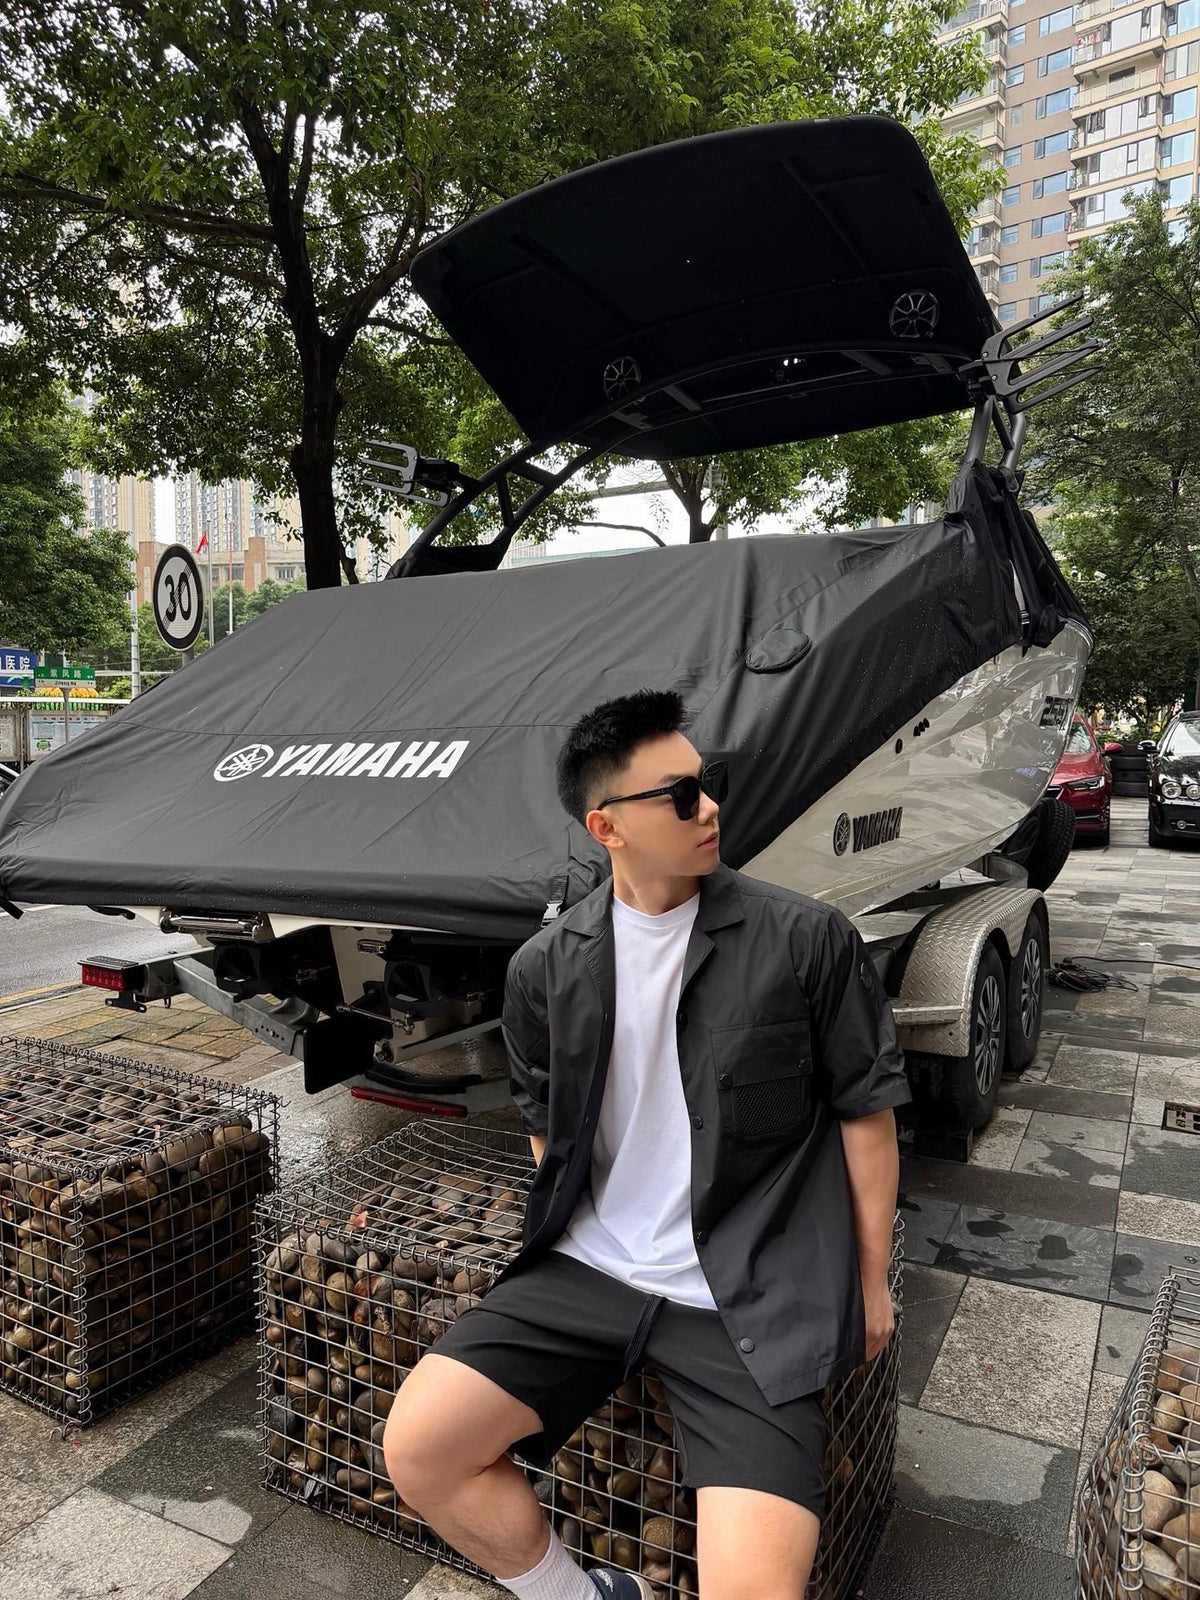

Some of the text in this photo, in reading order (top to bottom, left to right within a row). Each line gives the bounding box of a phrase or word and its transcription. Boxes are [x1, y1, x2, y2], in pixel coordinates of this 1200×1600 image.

[165, 572, 191, 622] 30
[0, 655, 31, 671] 医院
[261, 740, 470, 778] YAMAHA
[852, 806, 903, 853] YAMAHA
